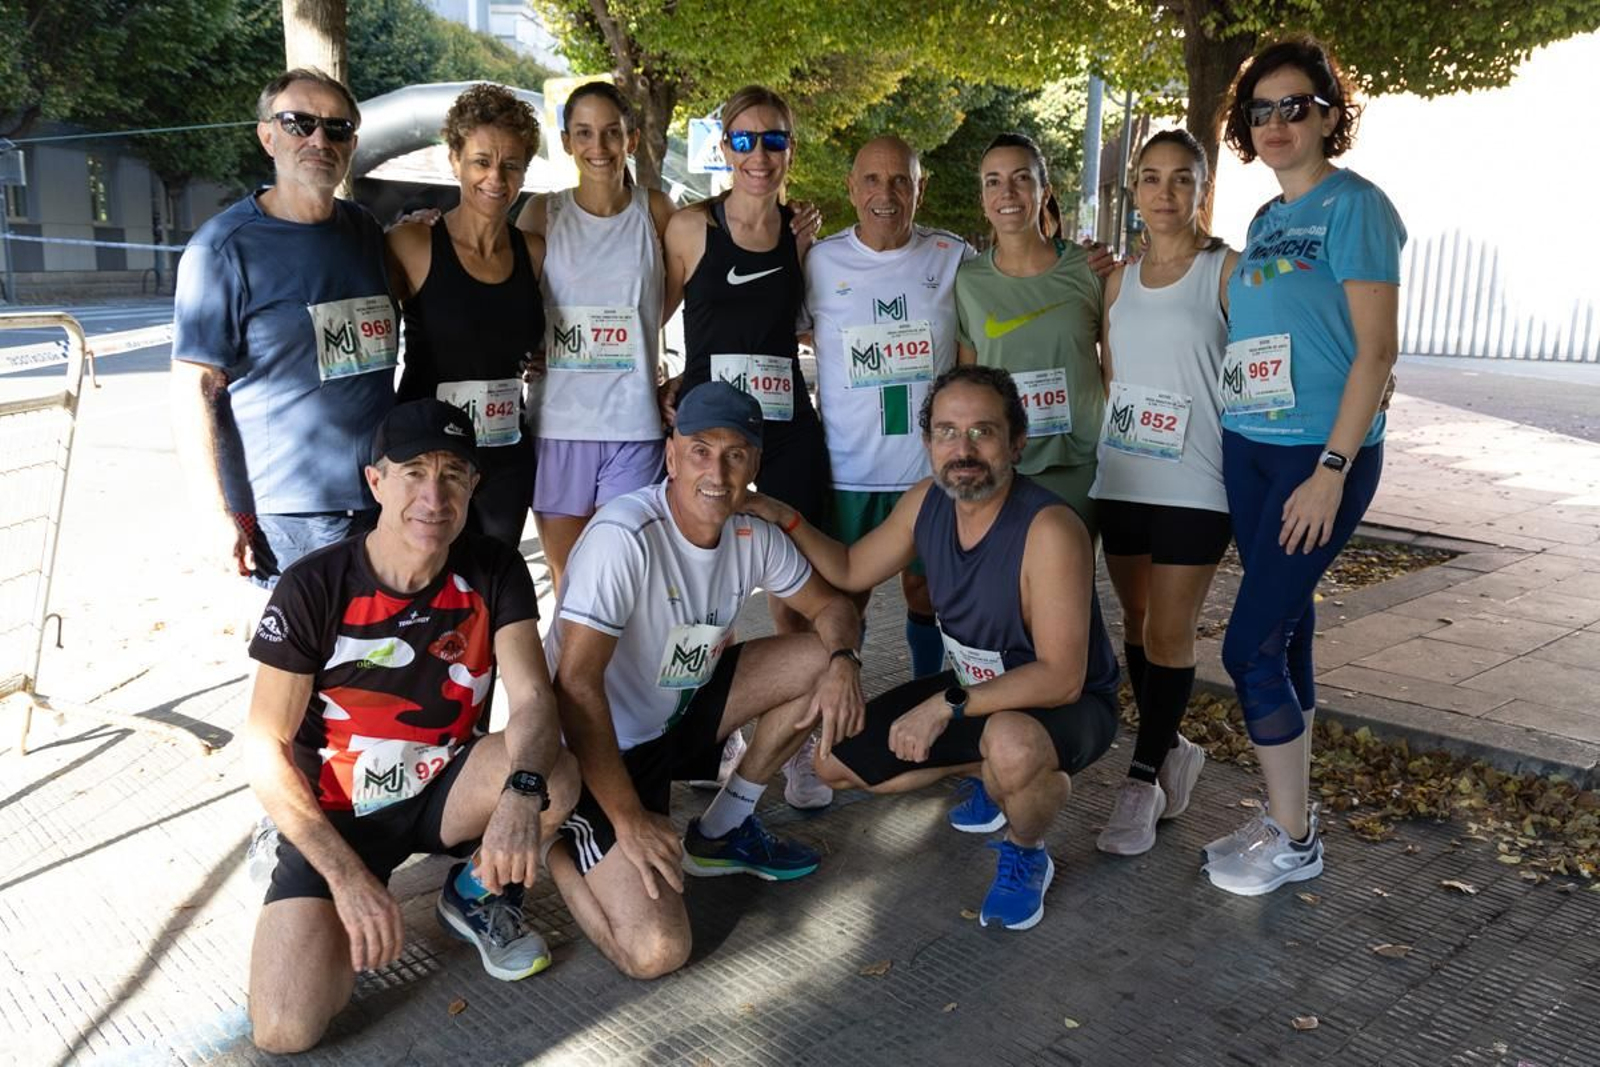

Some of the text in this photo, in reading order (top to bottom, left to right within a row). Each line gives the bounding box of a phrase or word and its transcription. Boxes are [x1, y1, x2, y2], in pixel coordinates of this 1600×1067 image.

[361, 319, 392, 338] 968
[591, 328, 627, 342] 770
[884, 340, 930, 358] 1102
[1248, 359, 1282, 379] 967
[750, 376, 791, 392] 1078
[1021, 390, 1066, 408] 1105
[485, 401, 514, 418] 842
[1140, 411, 1178, 432] 852
[961, 661, 995, 680] 789
